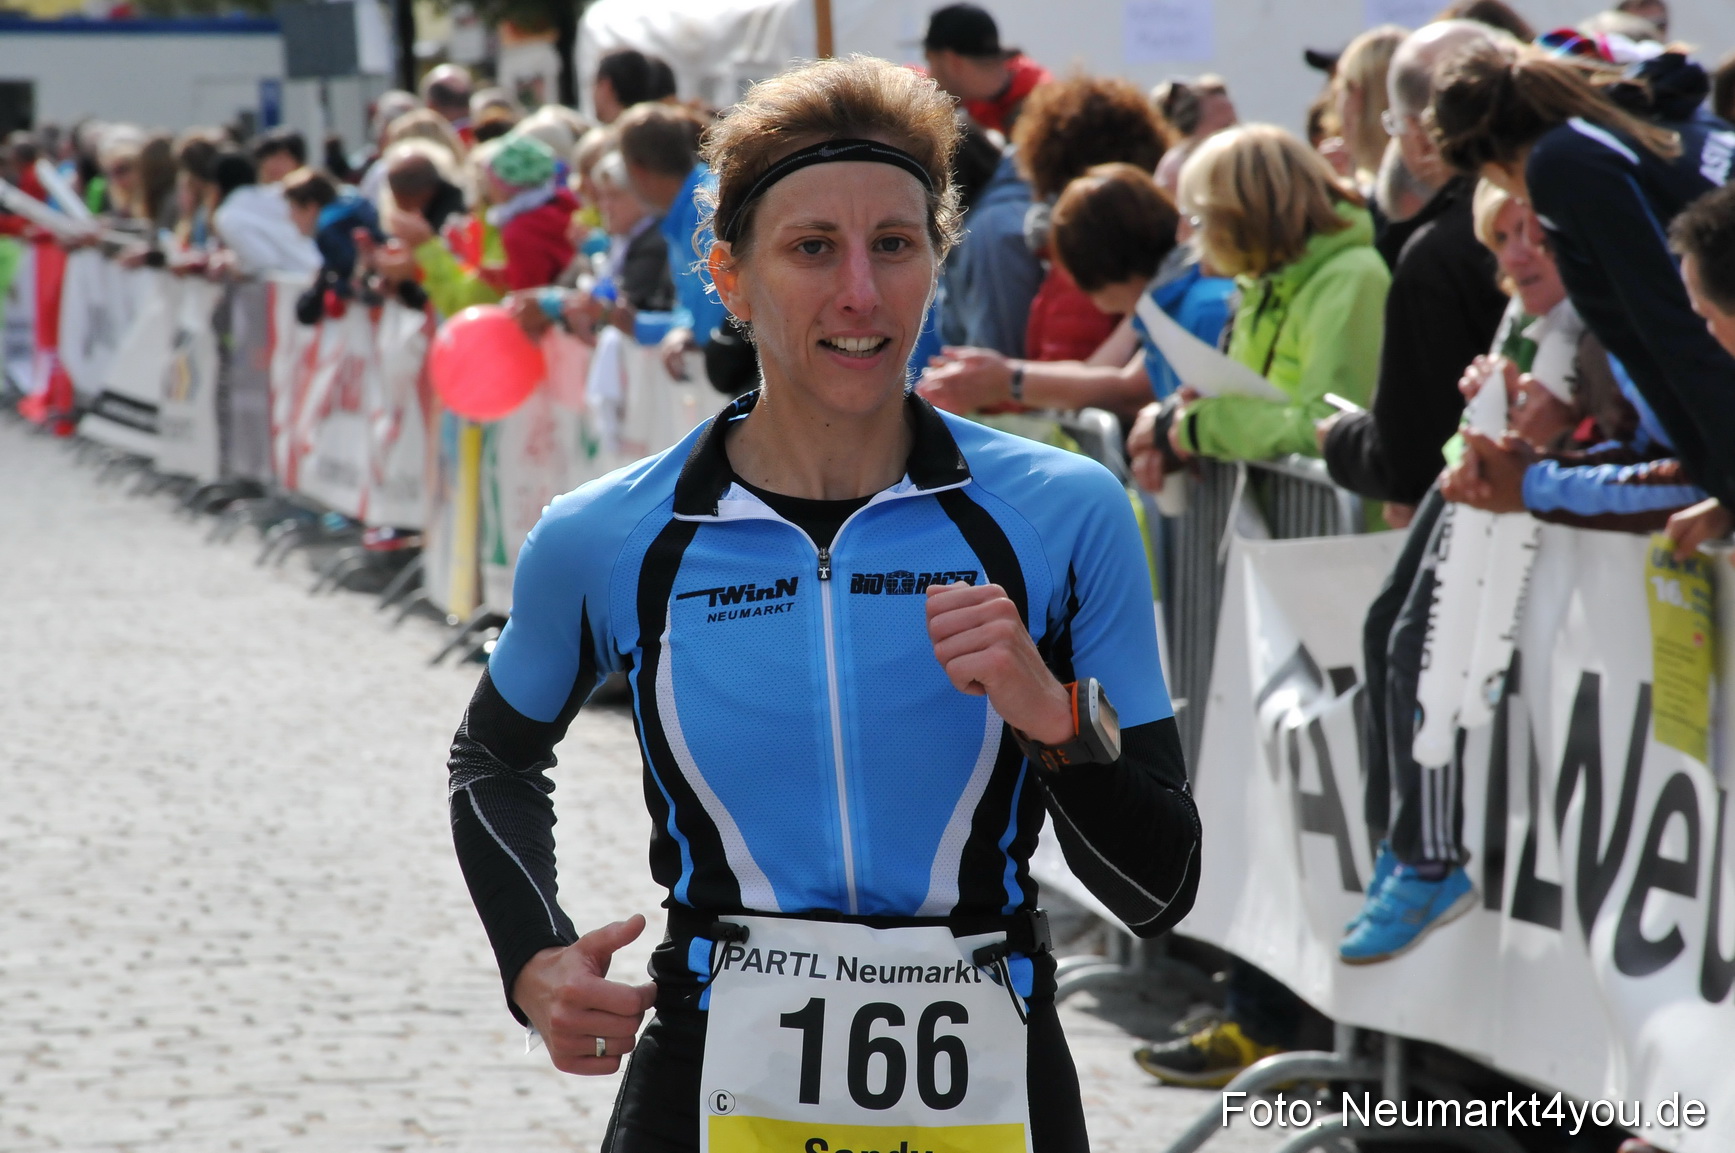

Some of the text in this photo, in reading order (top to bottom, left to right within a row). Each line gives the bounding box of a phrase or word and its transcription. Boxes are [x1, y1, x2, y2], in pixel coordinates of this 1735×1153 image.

[707, 602, 795, 624] NEUMARKT
[724, 946, 981, 985] PARTL Neumarkt
[780, 997, 969, 1110] 166
